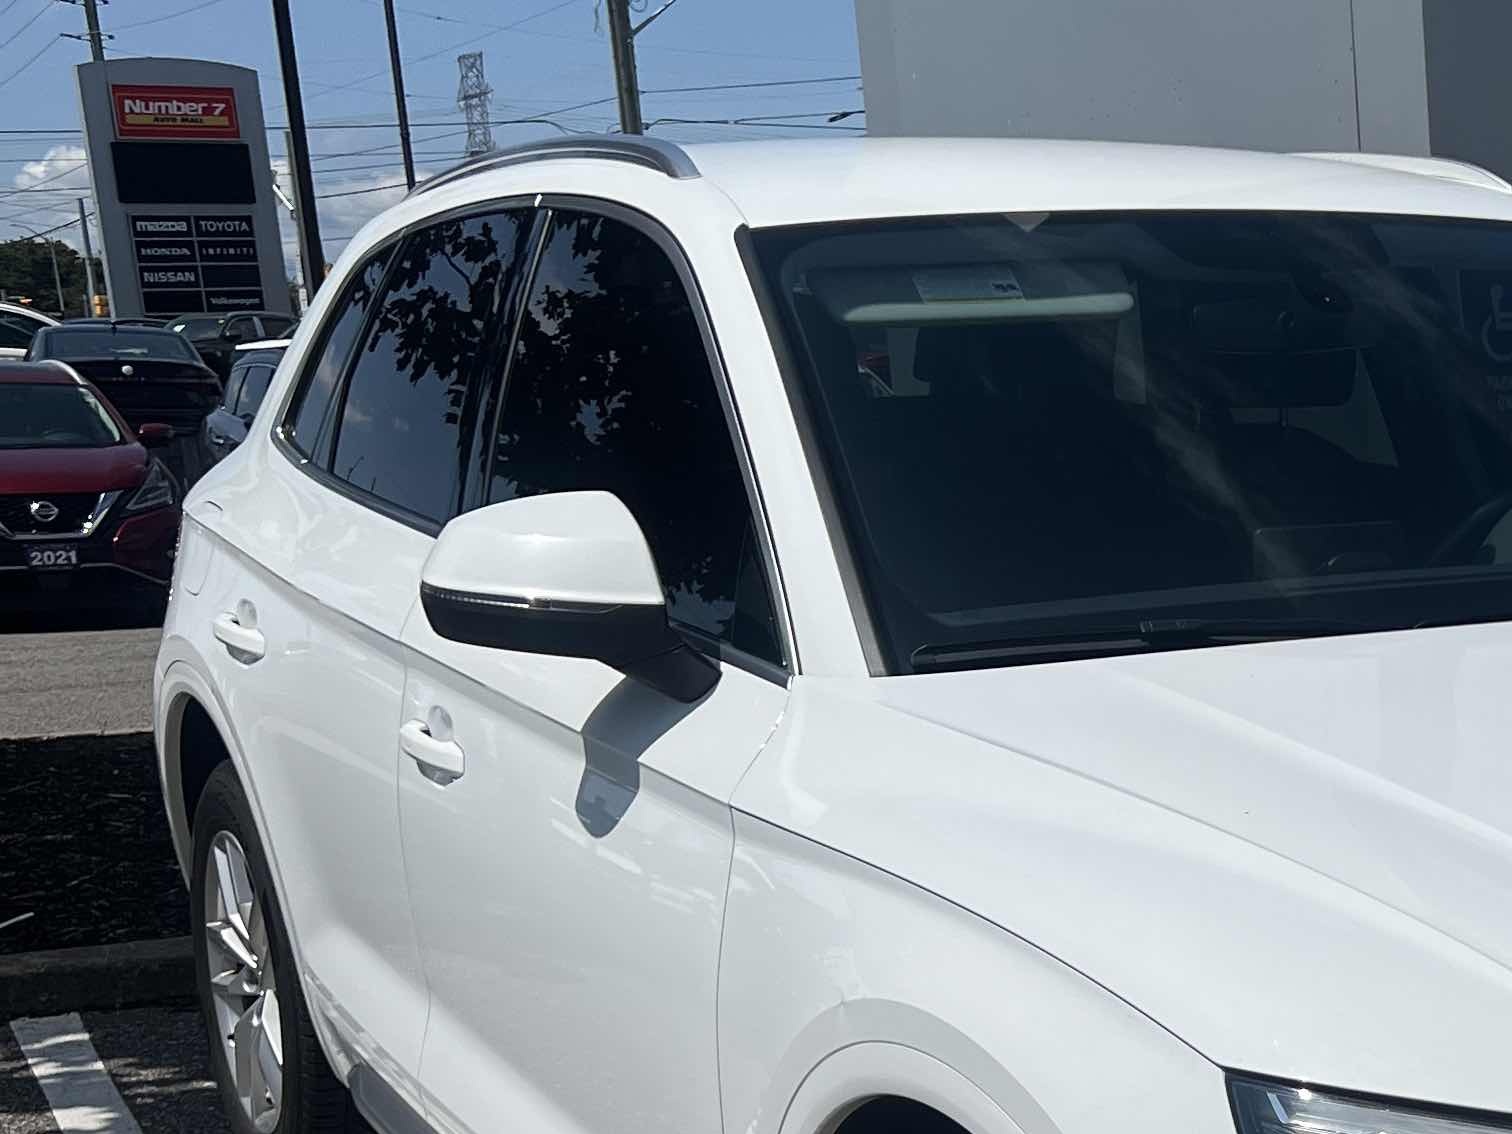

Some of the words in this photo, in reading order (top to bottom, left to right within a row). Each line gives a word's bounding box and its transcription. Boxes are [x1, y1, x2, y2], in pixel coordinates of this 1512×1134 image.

[124, 99, 208, 115] Number
[211, 103, 226, 116] 7
[199, 221, 249, 232] TOYOTA
[140, 247, 191, 255] HONDA
[202, 247, 254, 255] INFINITI
[143, 271, 196, 282] NISSAN
[30, 550, 77, 566] 2021
